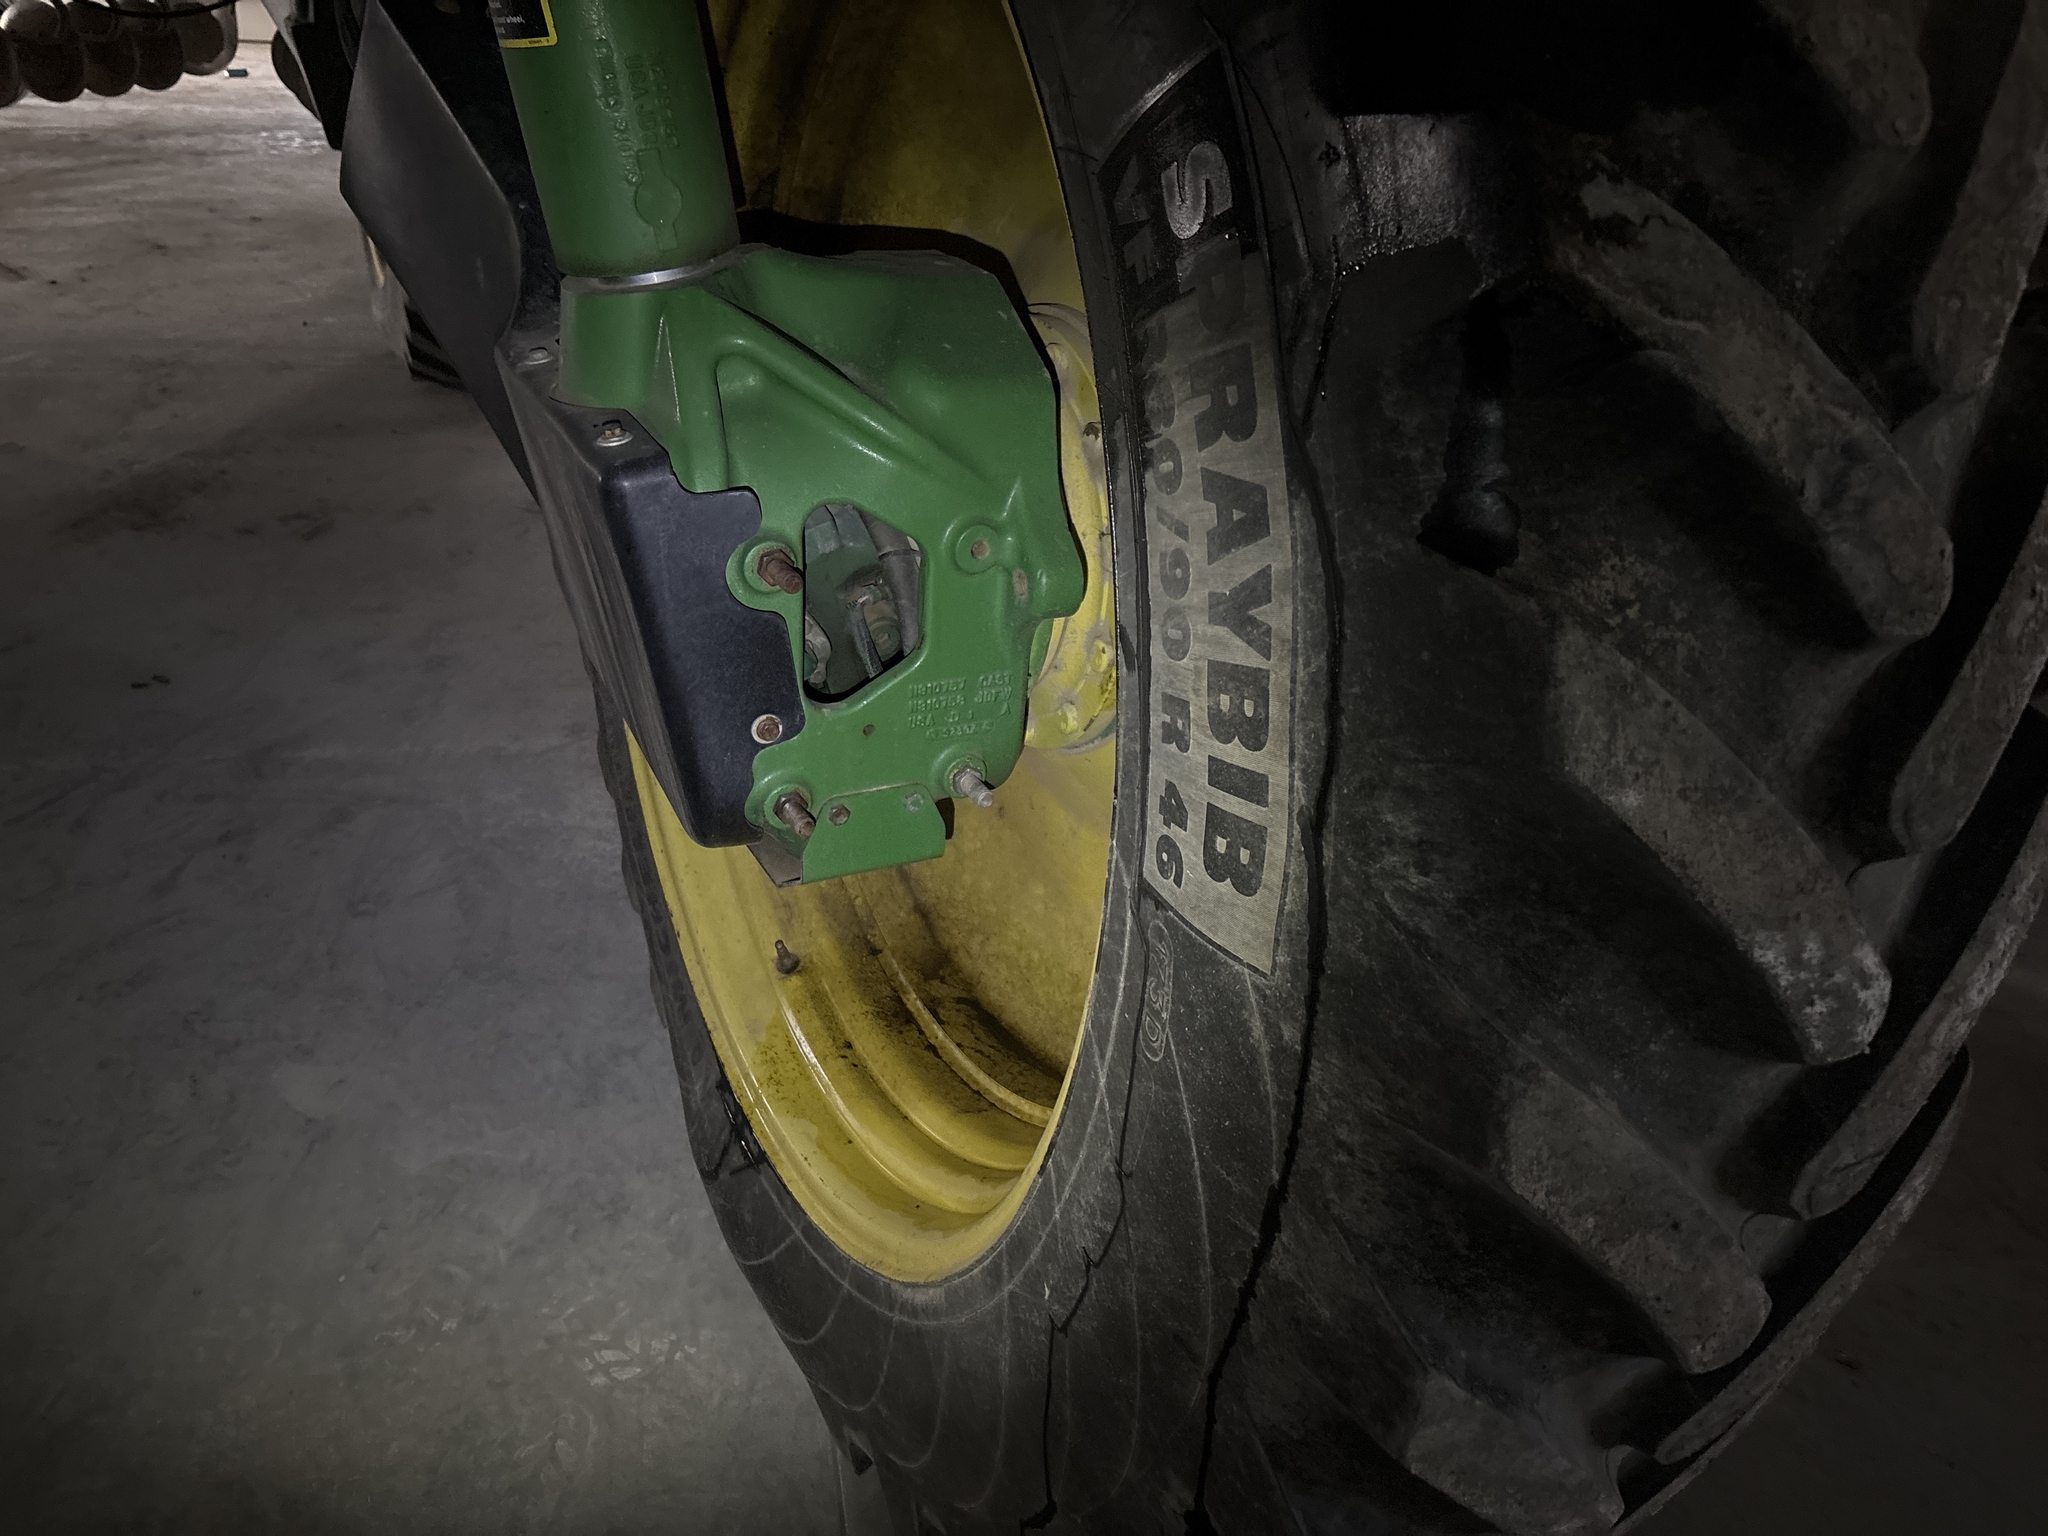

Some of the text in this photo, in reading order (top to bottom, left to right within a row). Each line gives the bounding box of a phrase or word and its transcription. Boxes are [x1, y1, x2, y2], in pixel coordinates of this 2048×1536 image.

[1160, 140, 1273, 897] SPRAYBIB
[1161, 692, 1191, 753] R
[1155, 778, 1189, 890] 46
